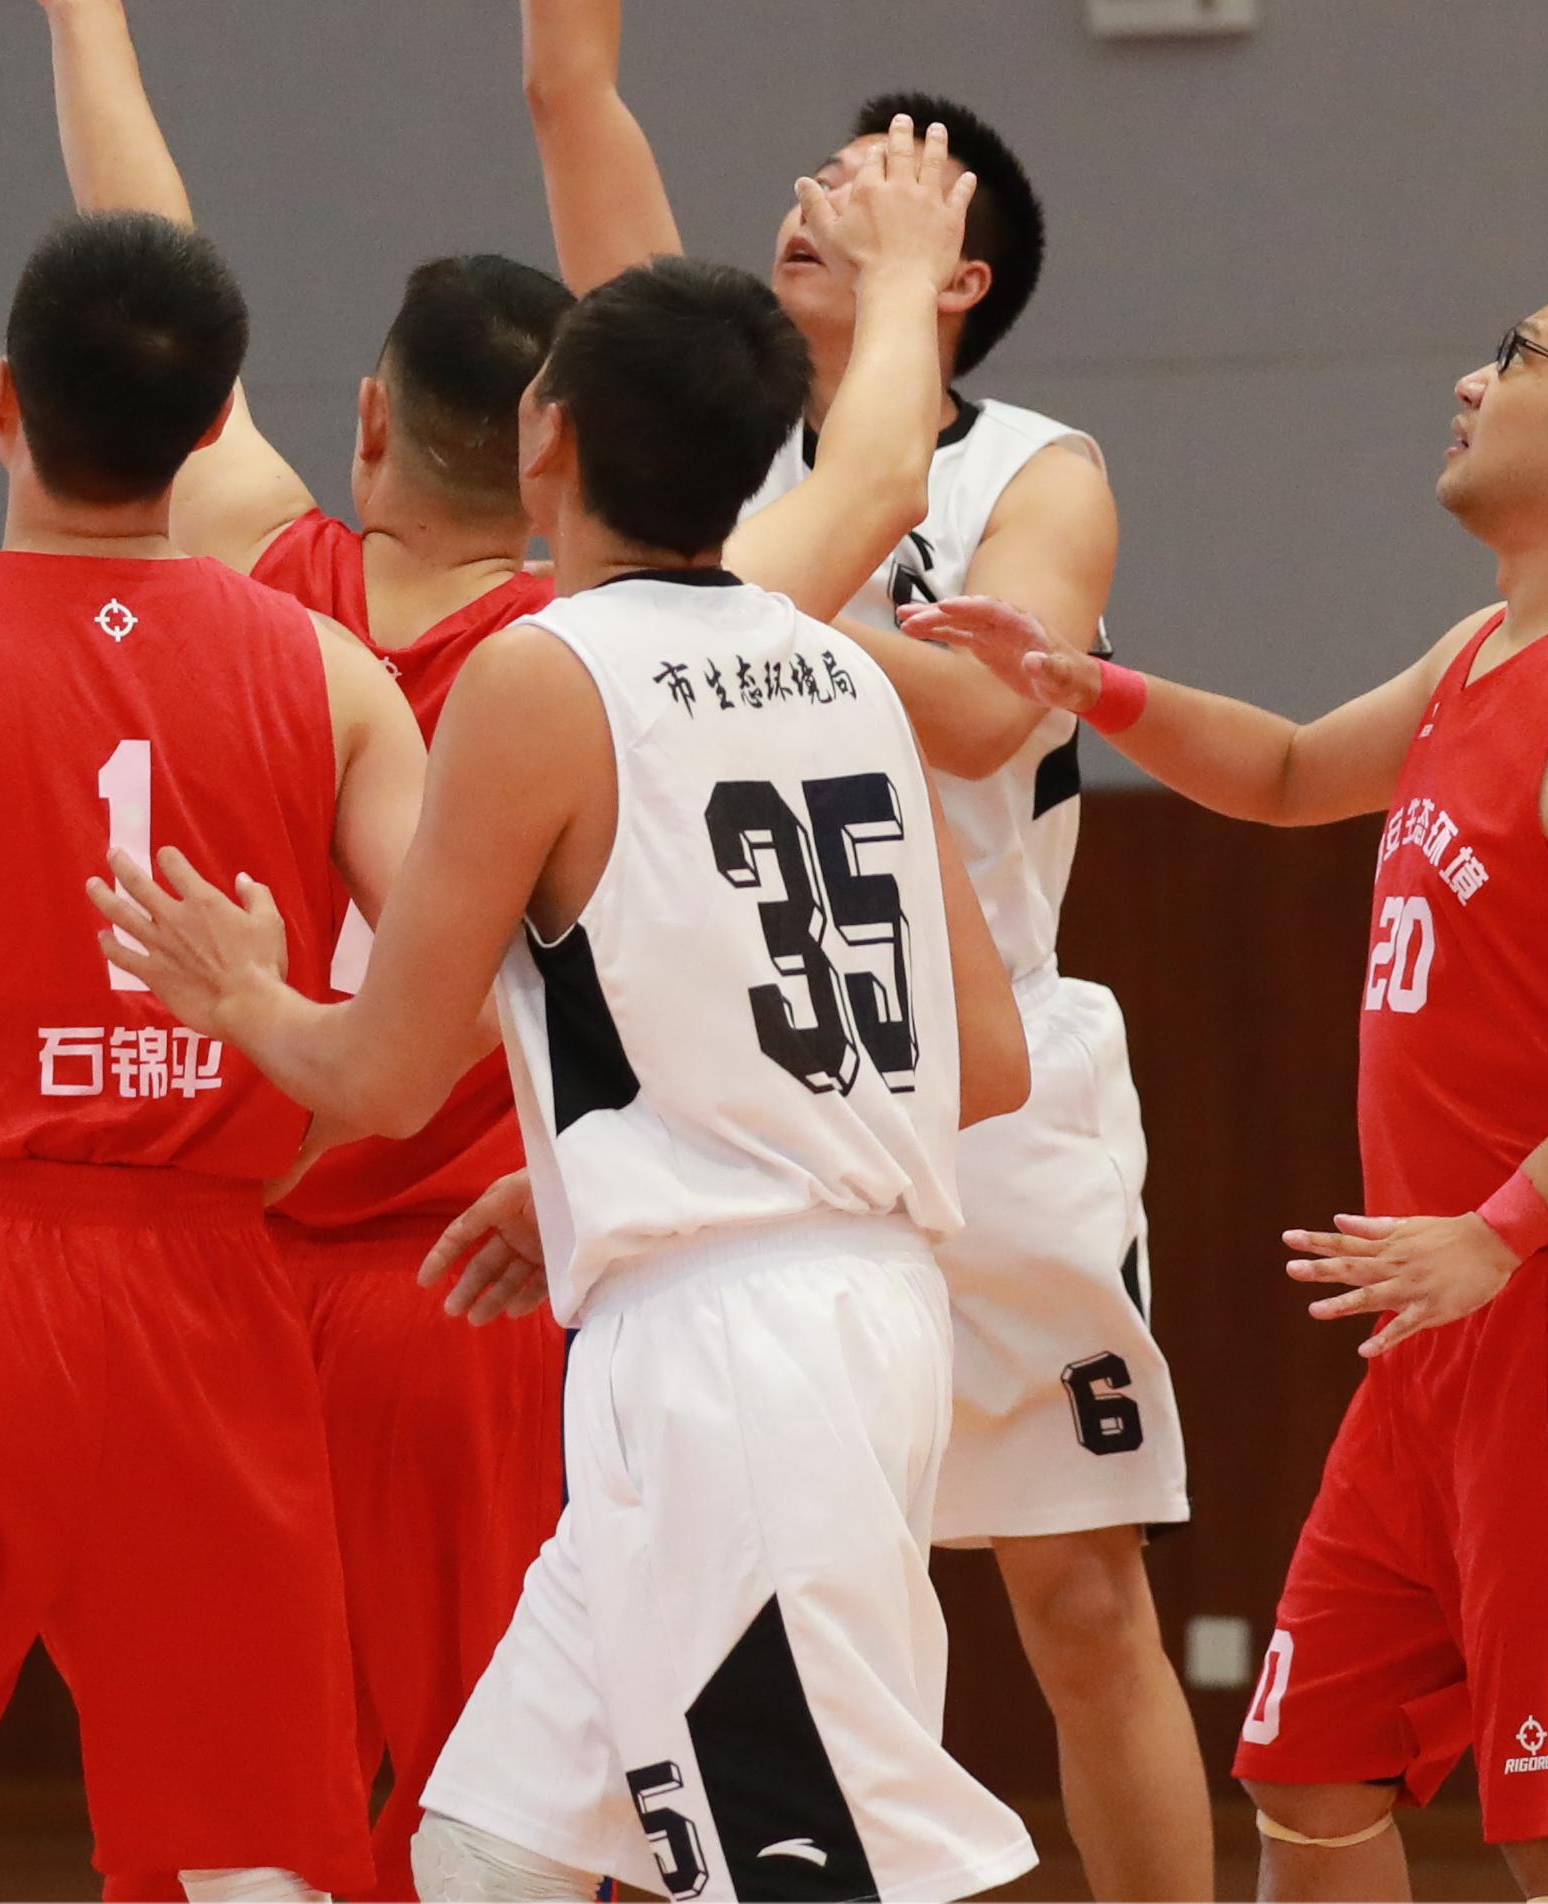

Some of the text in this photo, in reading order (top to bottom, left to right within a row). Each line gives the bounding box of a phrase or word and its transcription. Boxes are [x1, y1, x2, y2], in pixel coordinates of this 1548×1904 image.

[652, 649, 858, 721] 市生态环境局
[97, 739, 154, 992] 1
[704, 772, 920, 1098] 35
[1363, 895, 1436, 1015] 20
[1060, 1350, 1145, 1456] 6
[625, 1759, 710, 1902] 5
